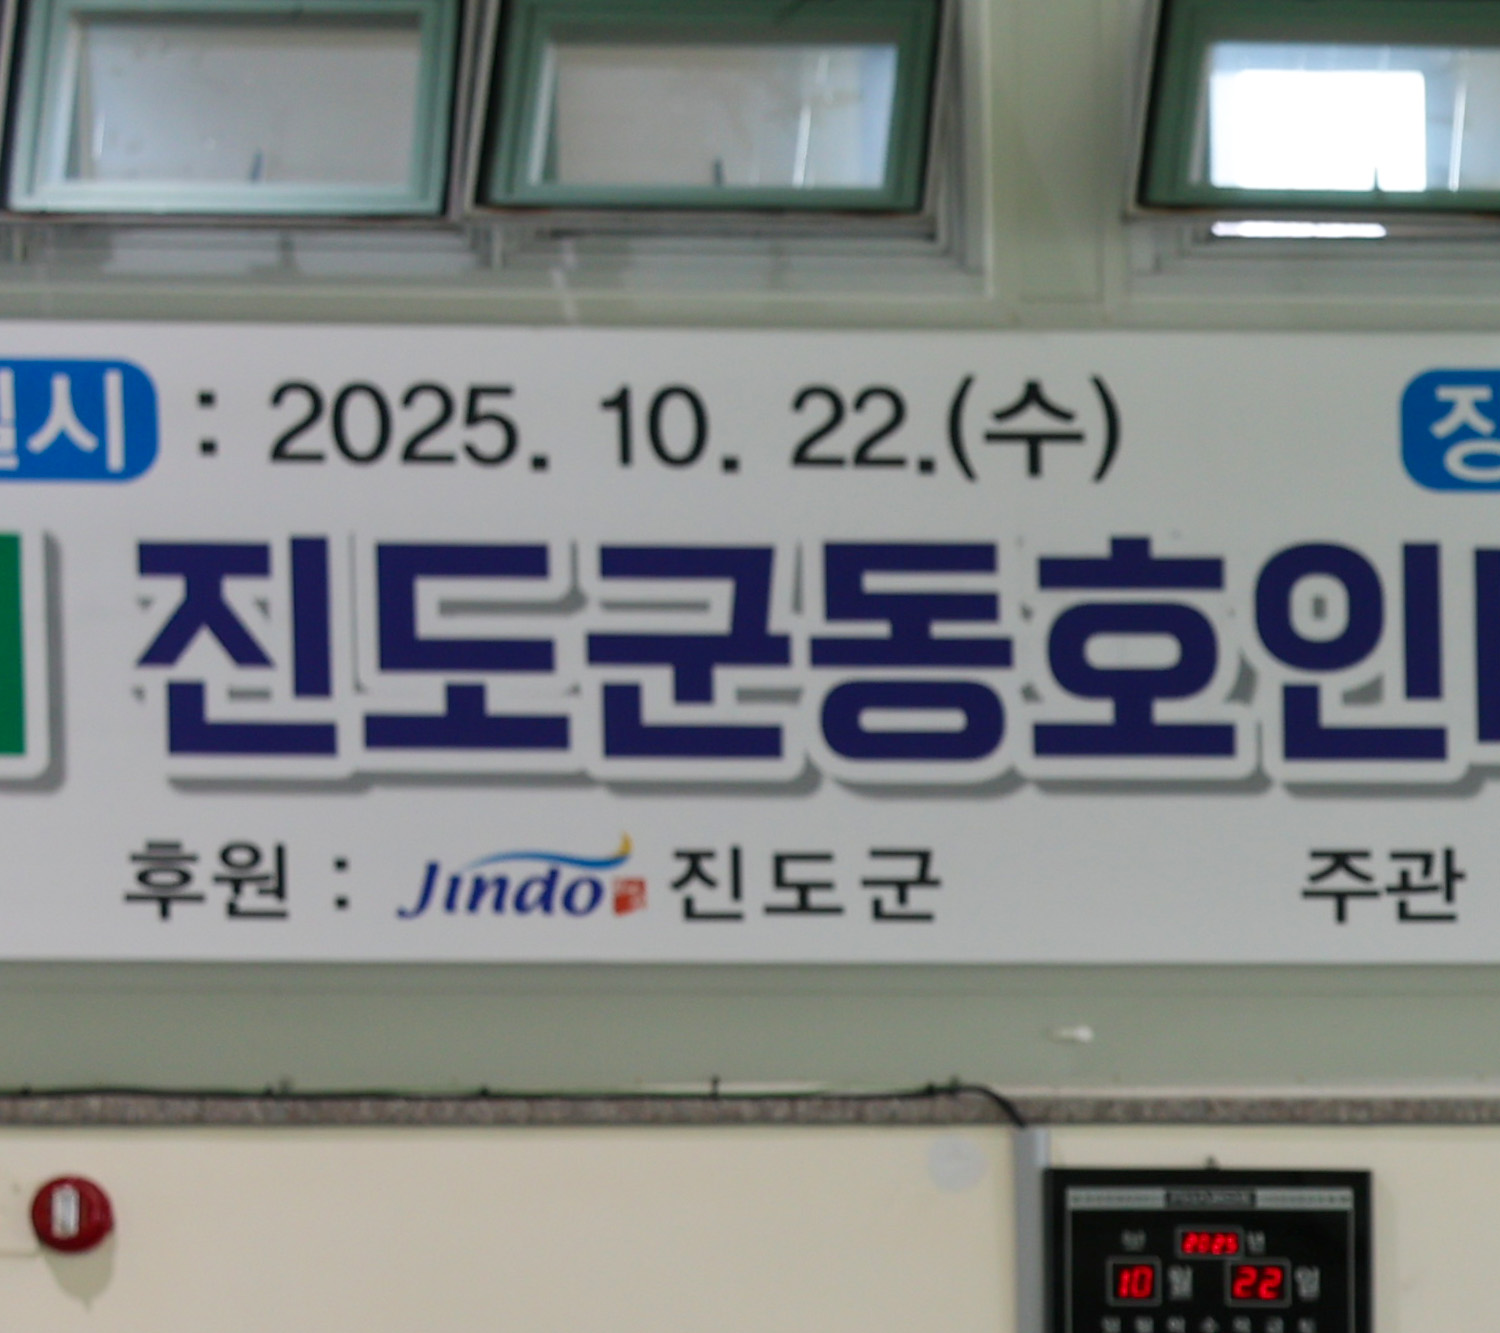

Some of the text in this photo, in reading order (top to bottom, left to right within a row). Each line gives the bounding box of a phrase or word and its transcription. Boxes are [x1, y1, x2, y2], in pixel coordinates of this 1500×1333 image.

[270, 381, 550, 472] 2025.
[601, 385, 741, 474] 10.
[791, 376, 1122, 484] 22.(수)
[124, 841, 291, 922] 후원
[397, 858, 605, 920] Jindo
[670, 845, 944, 924] 진도군
[1300, 847, 1468, 926] 주관
[1118, 1265, 1155, 1299] 10
[1232, 1265, 1284, 1300] 22
